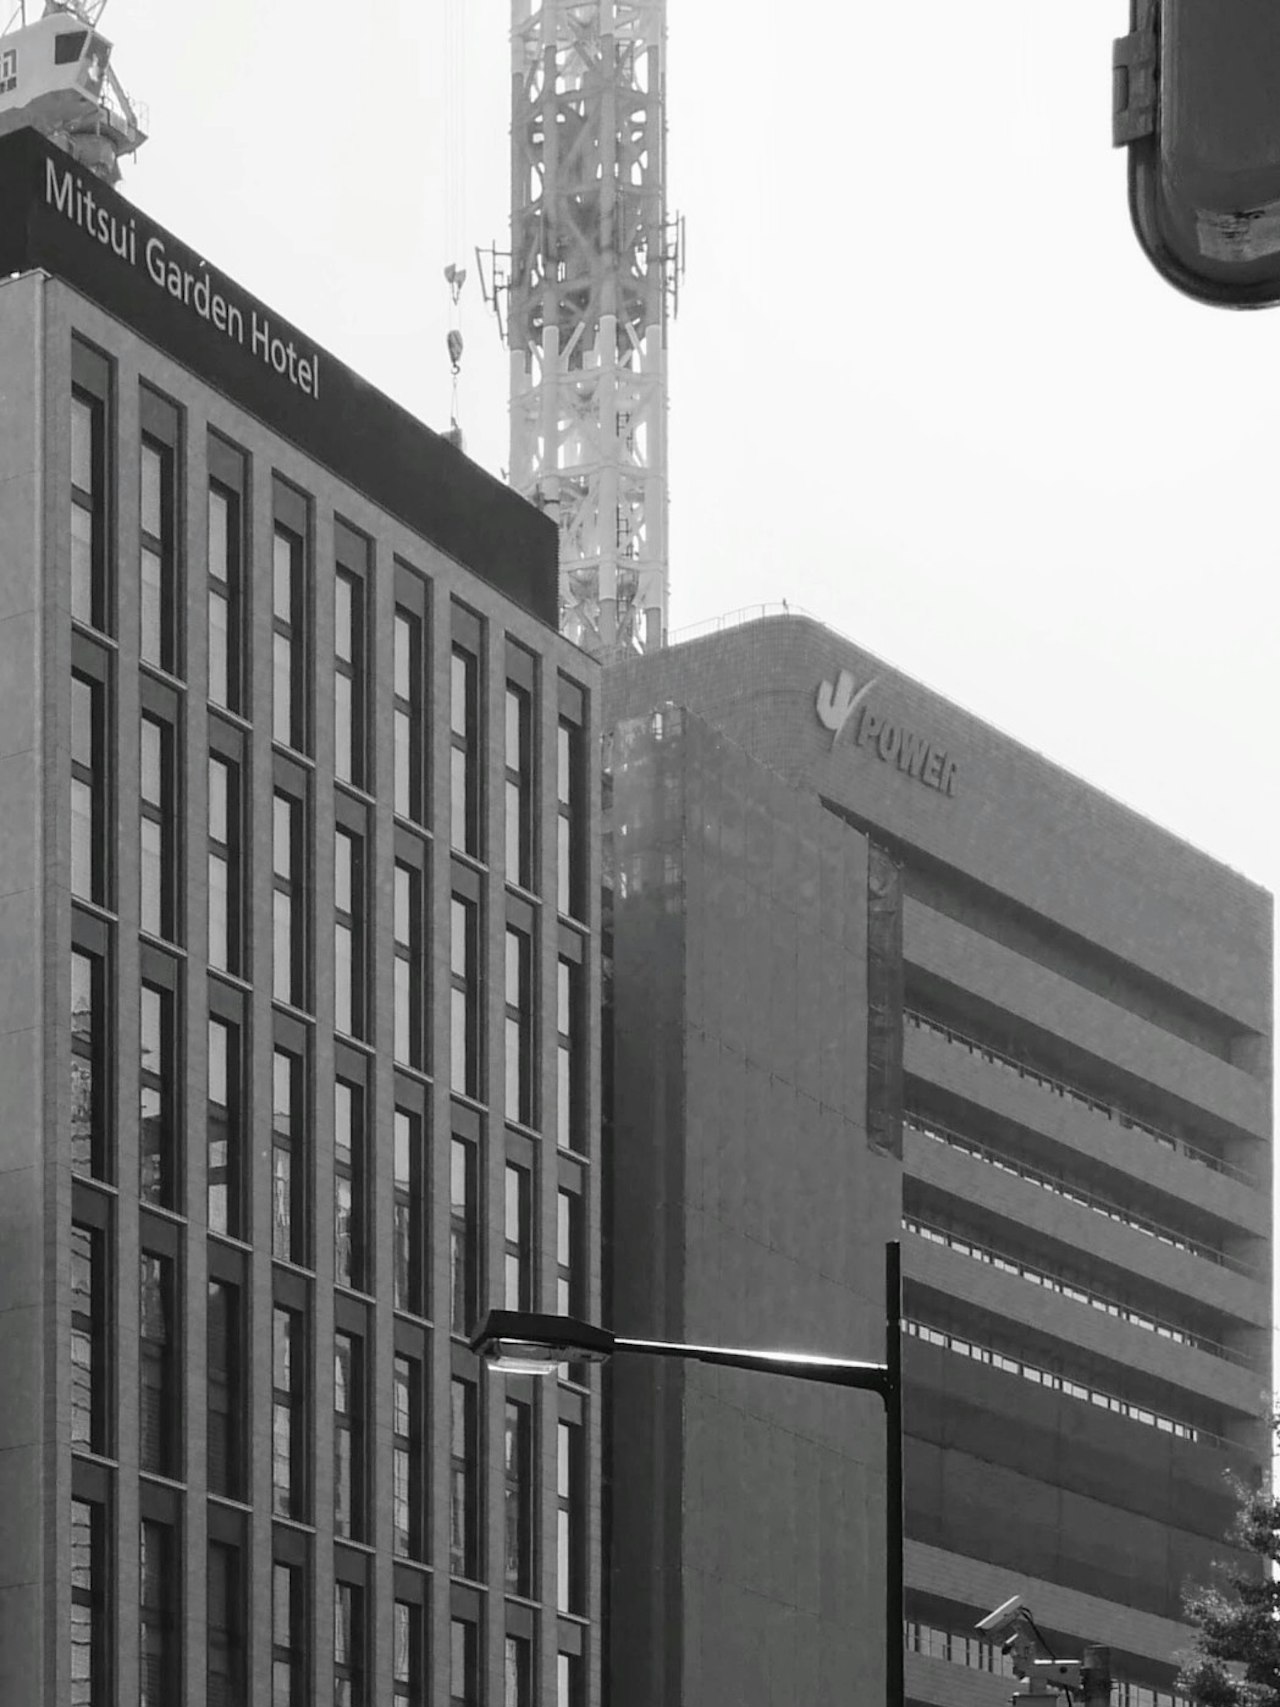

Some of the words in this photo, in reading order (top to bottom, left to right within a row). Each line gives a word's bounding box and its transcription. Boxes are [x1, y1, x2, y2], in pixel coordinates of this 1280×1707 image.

[44, 158, 137, 266] Mitsui
[144, 238, 245, 344] Garden
[251, 311, 320, 400] Hotel
[855, 705, 959, 799] POWER
